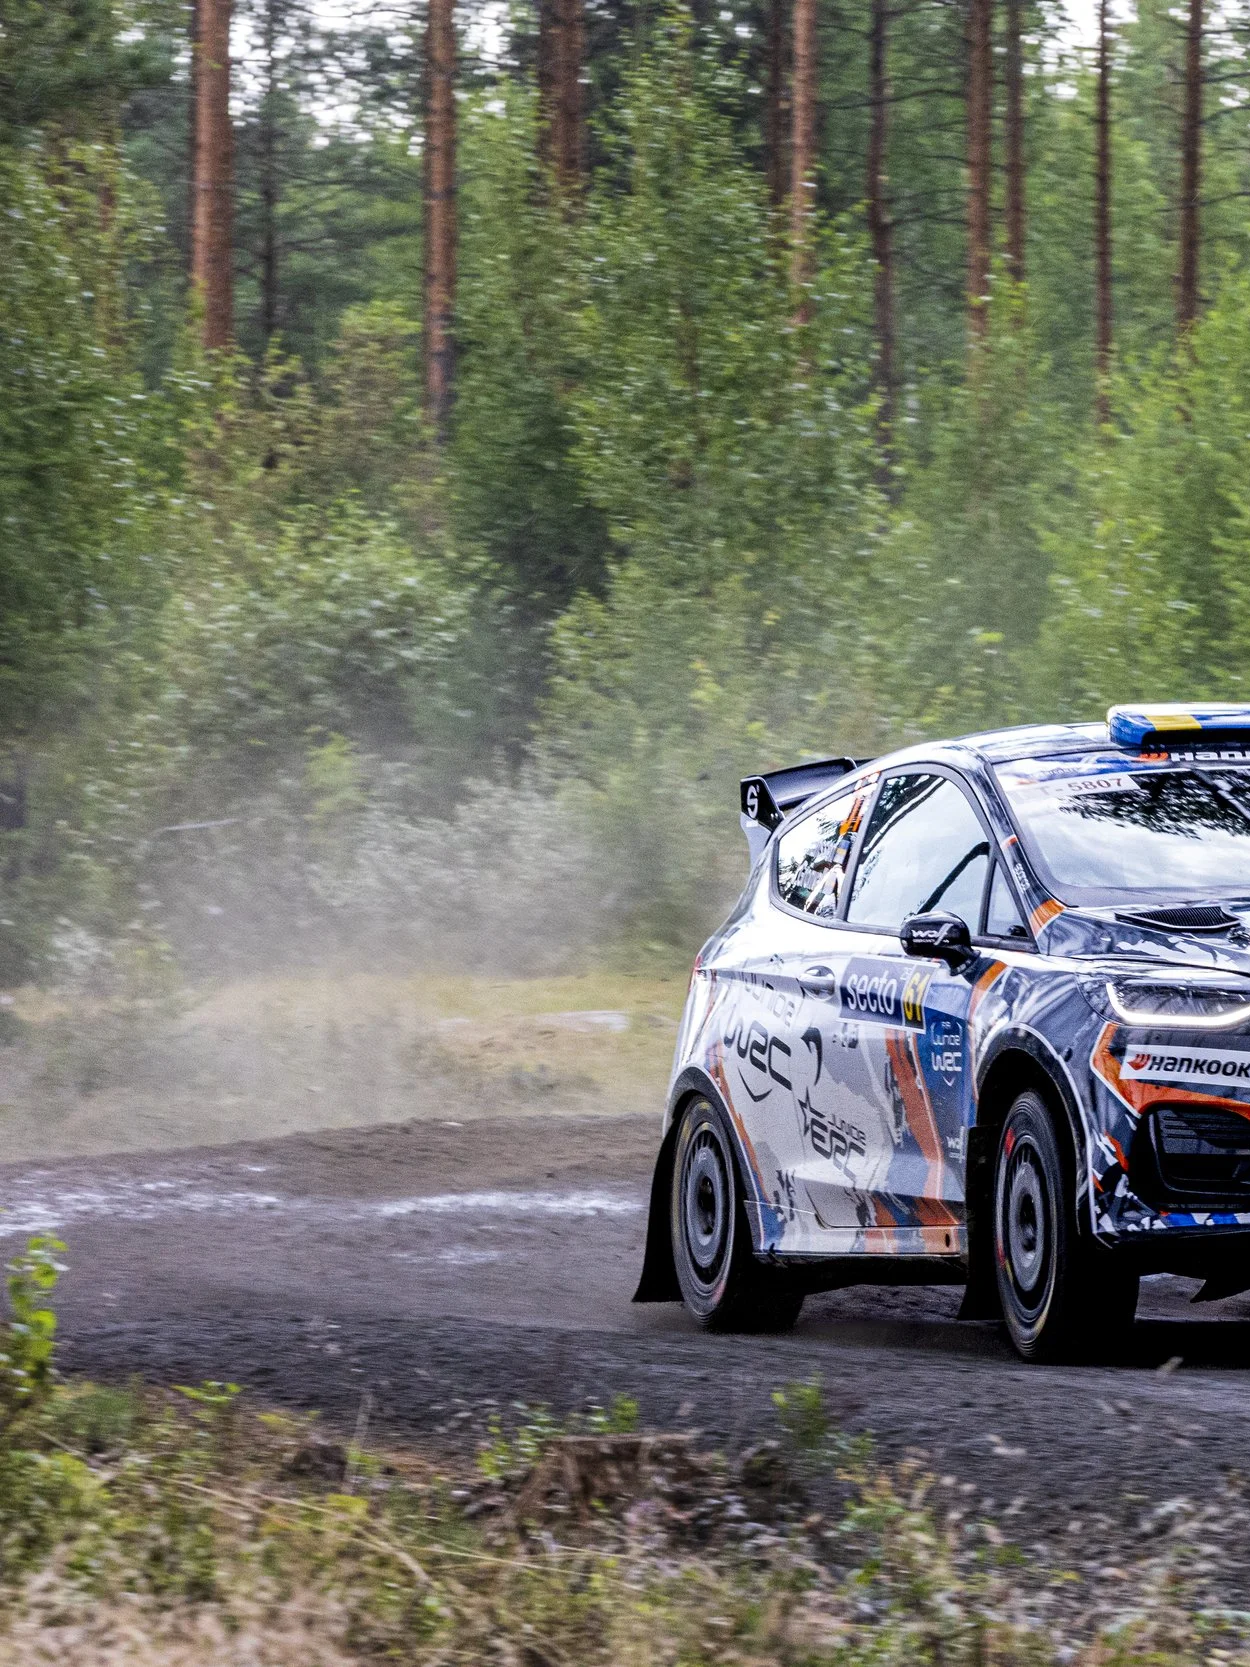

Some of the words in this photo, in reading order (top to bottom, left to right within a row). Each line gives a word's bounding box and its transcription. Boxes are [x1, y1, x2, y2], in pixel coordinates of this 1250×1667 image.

[846, 970, 898, 1016] secto
[903, 971, 931, 1022] 61
[931, 1051, 963, 1073] WRC
